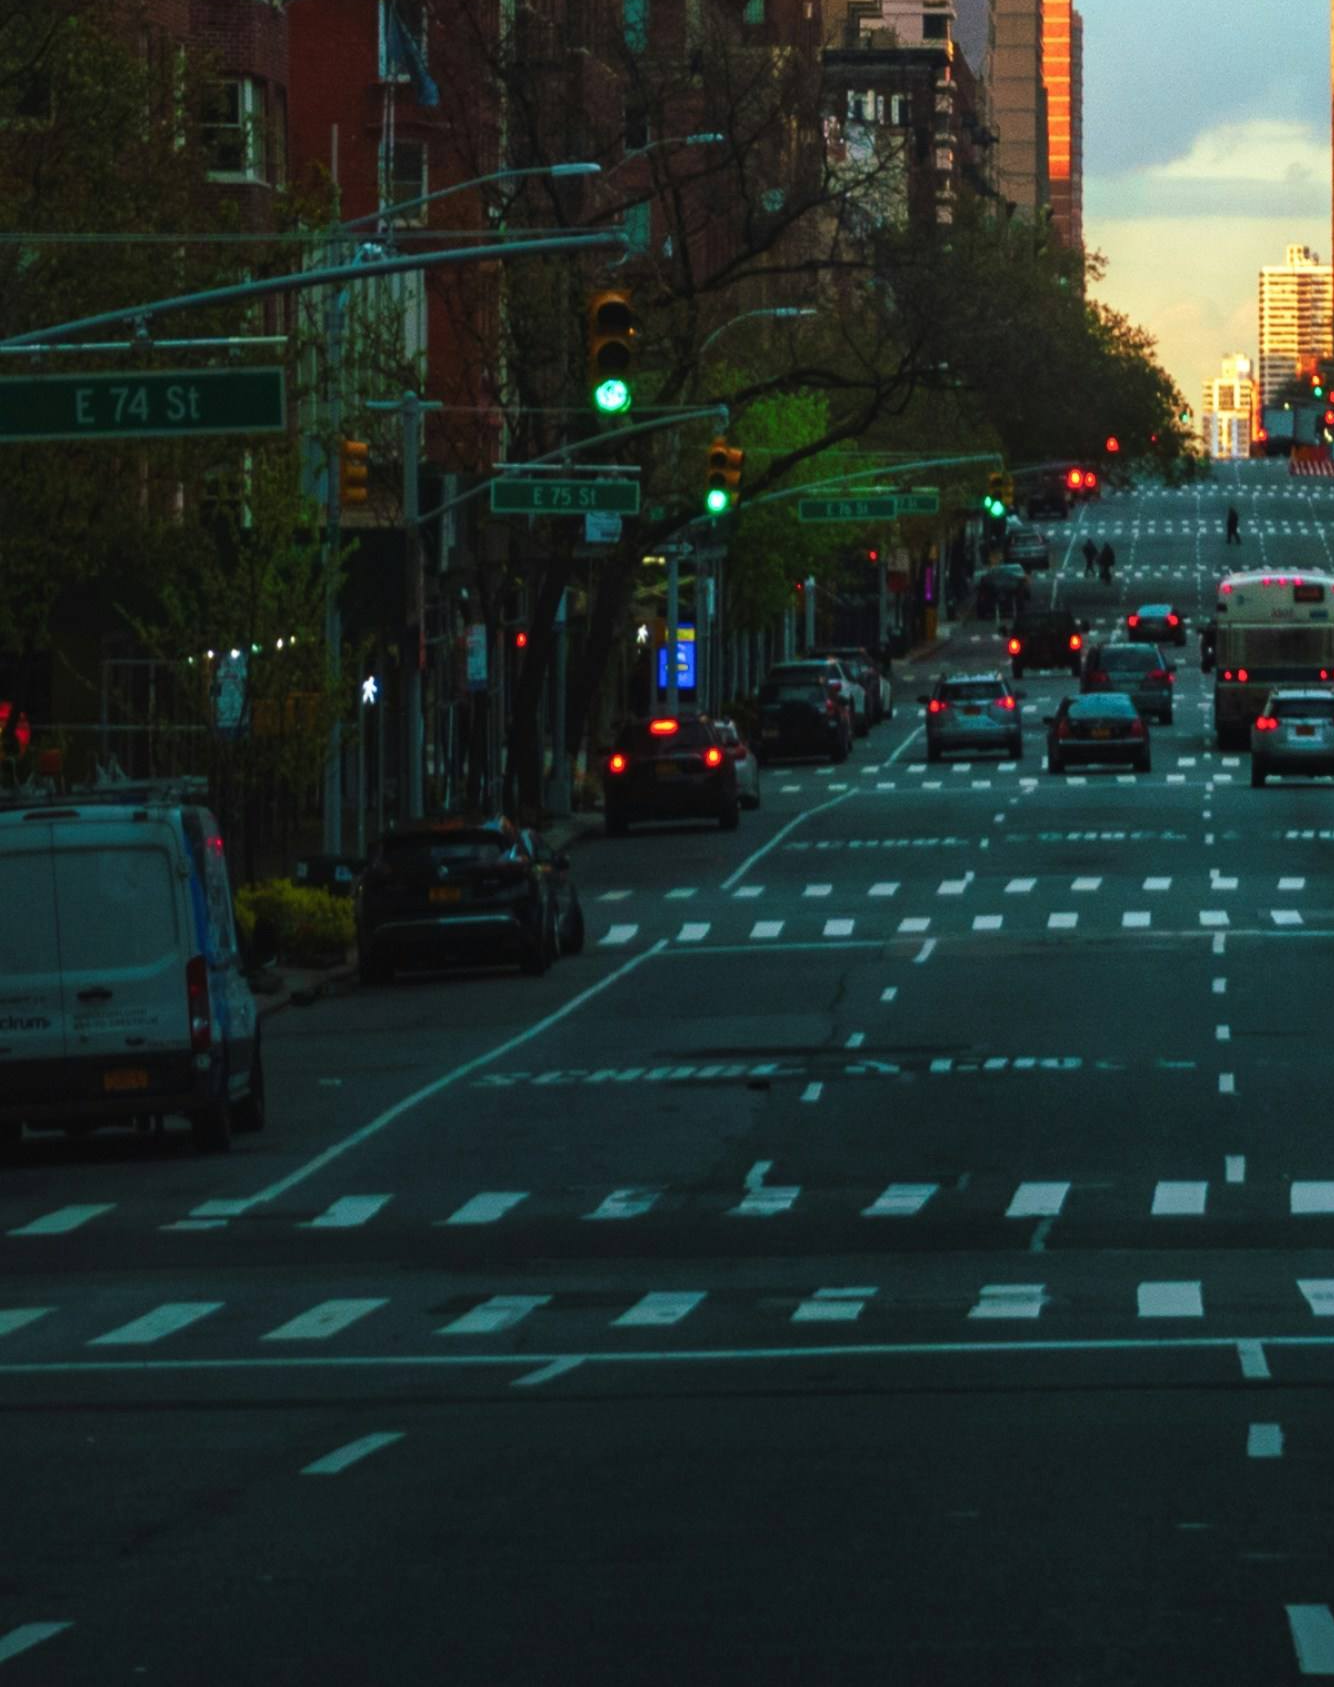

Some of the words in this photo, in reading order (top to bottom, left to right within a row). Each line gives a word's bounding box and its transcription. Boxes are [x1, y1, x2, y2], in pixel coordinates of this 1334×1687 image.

[74, 388, 95, 424] E
[109, 386, 149, 423] 74
[166, 384, 200, 421] St
[532, 486, 544, 506] E
[551, 486, 572, 506] 75
[579, 486, 598, 506] St
